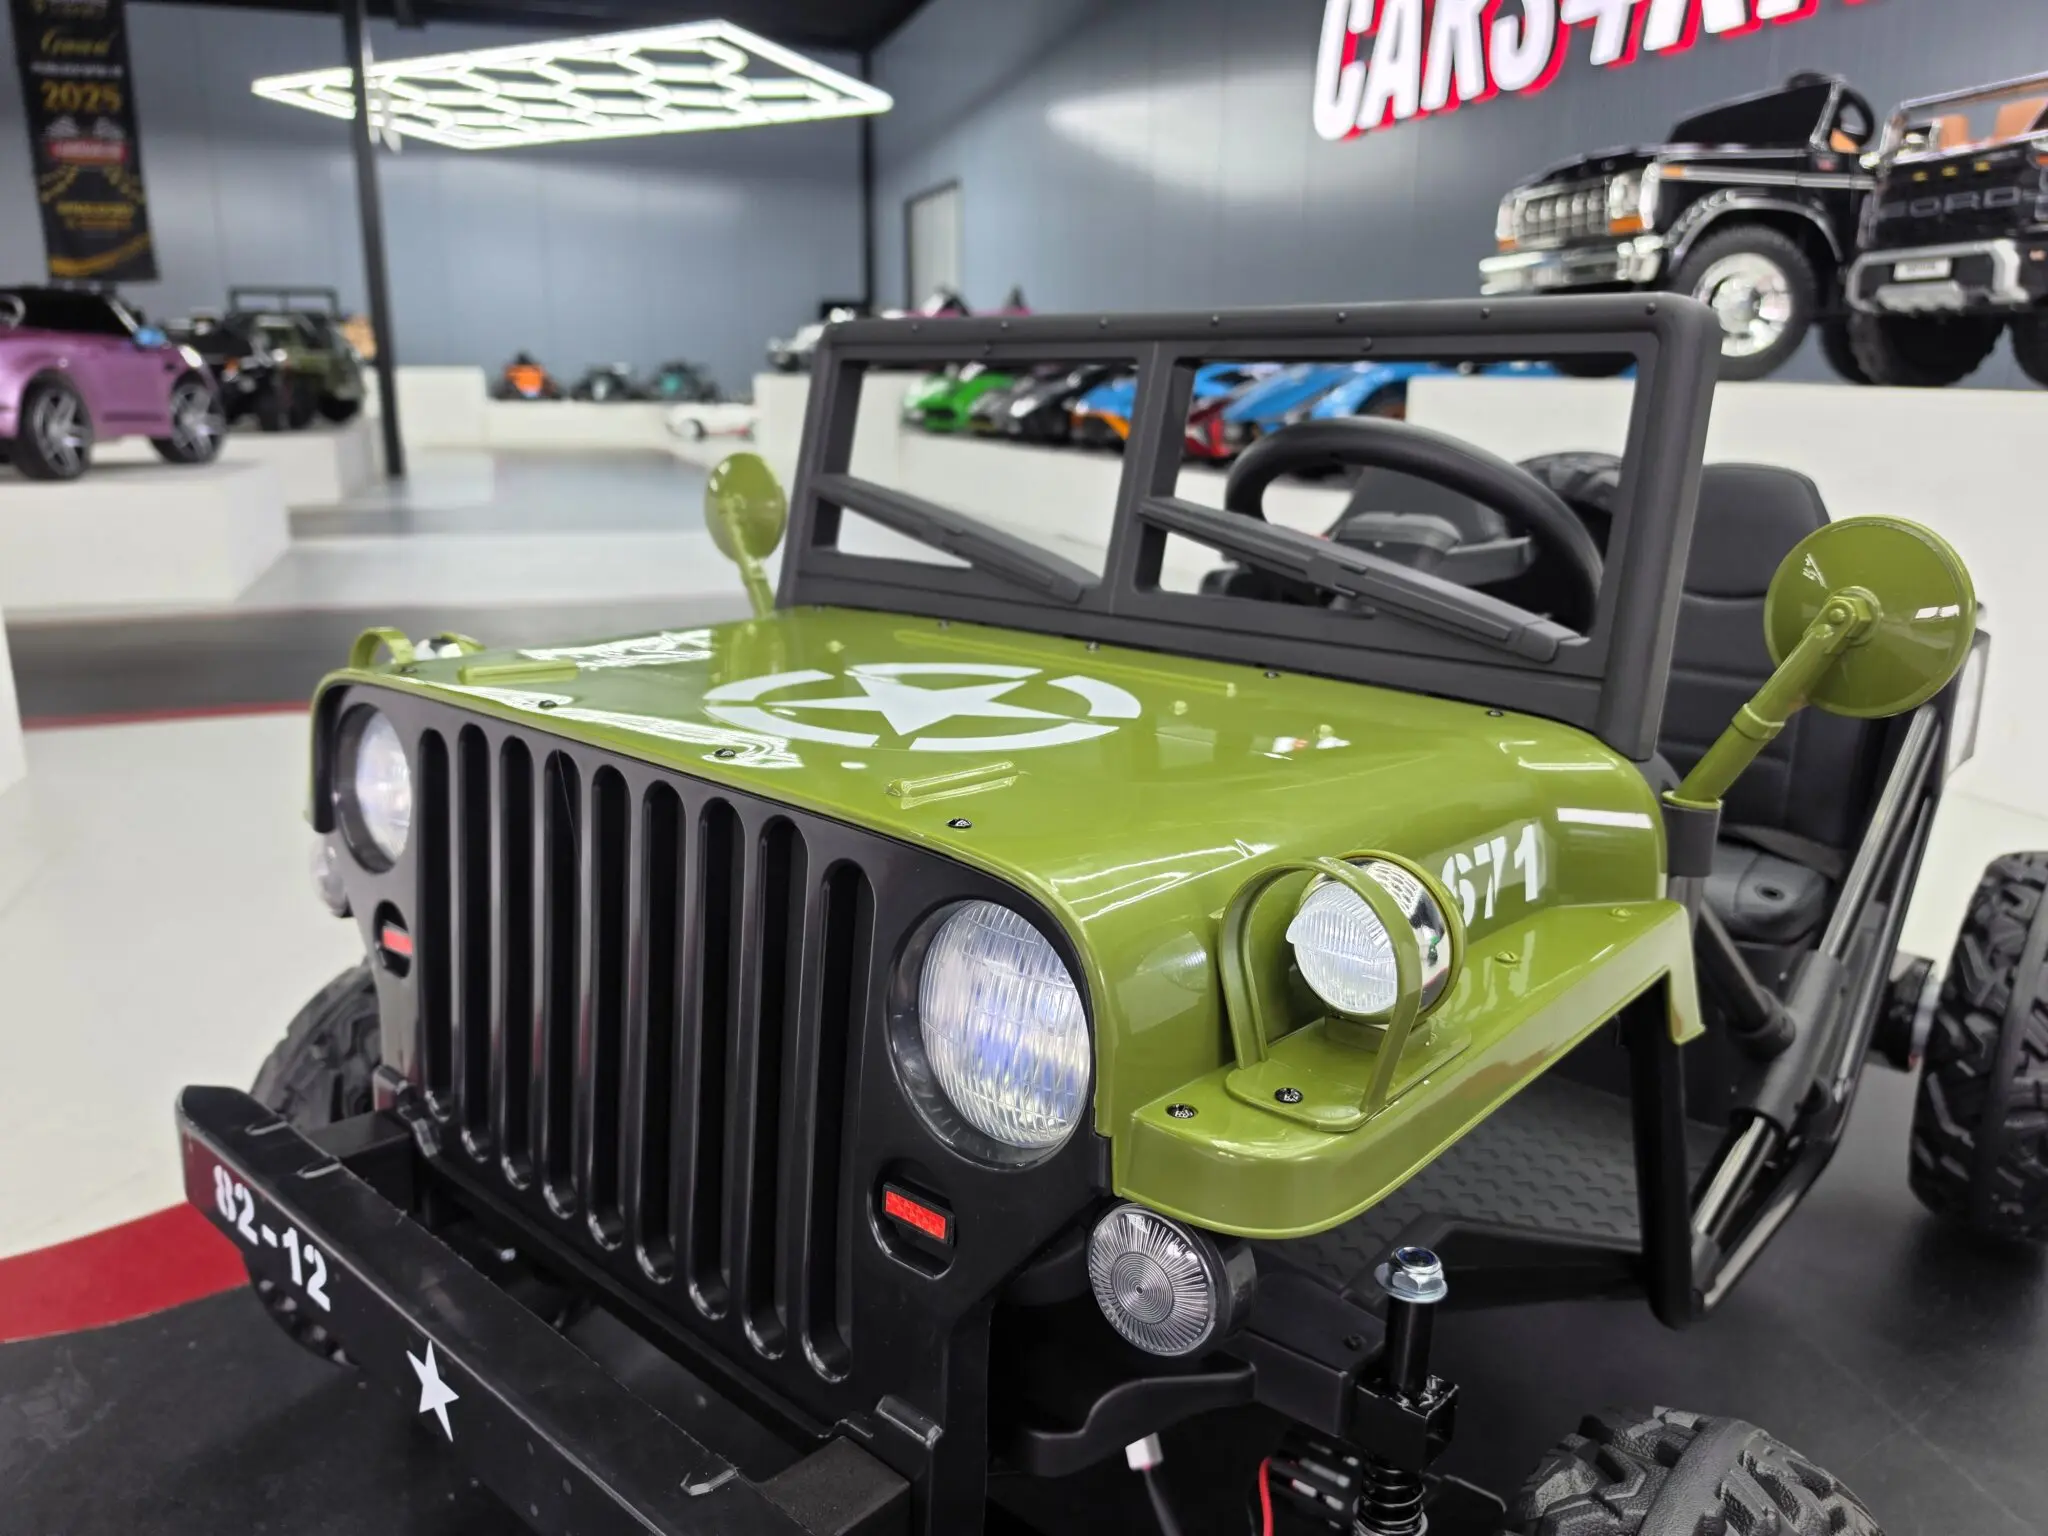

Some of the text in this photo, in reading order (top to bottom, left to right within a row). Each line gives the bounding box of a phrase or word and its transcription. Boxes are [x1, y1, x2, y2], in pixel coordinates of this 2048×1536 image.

[41, 81, 122, 114] 2025
[1312, 0, 1806, 141] CARS
[1441, 824, 1538, 928] 671
[213, 1164, 331, 1312] 82-12
